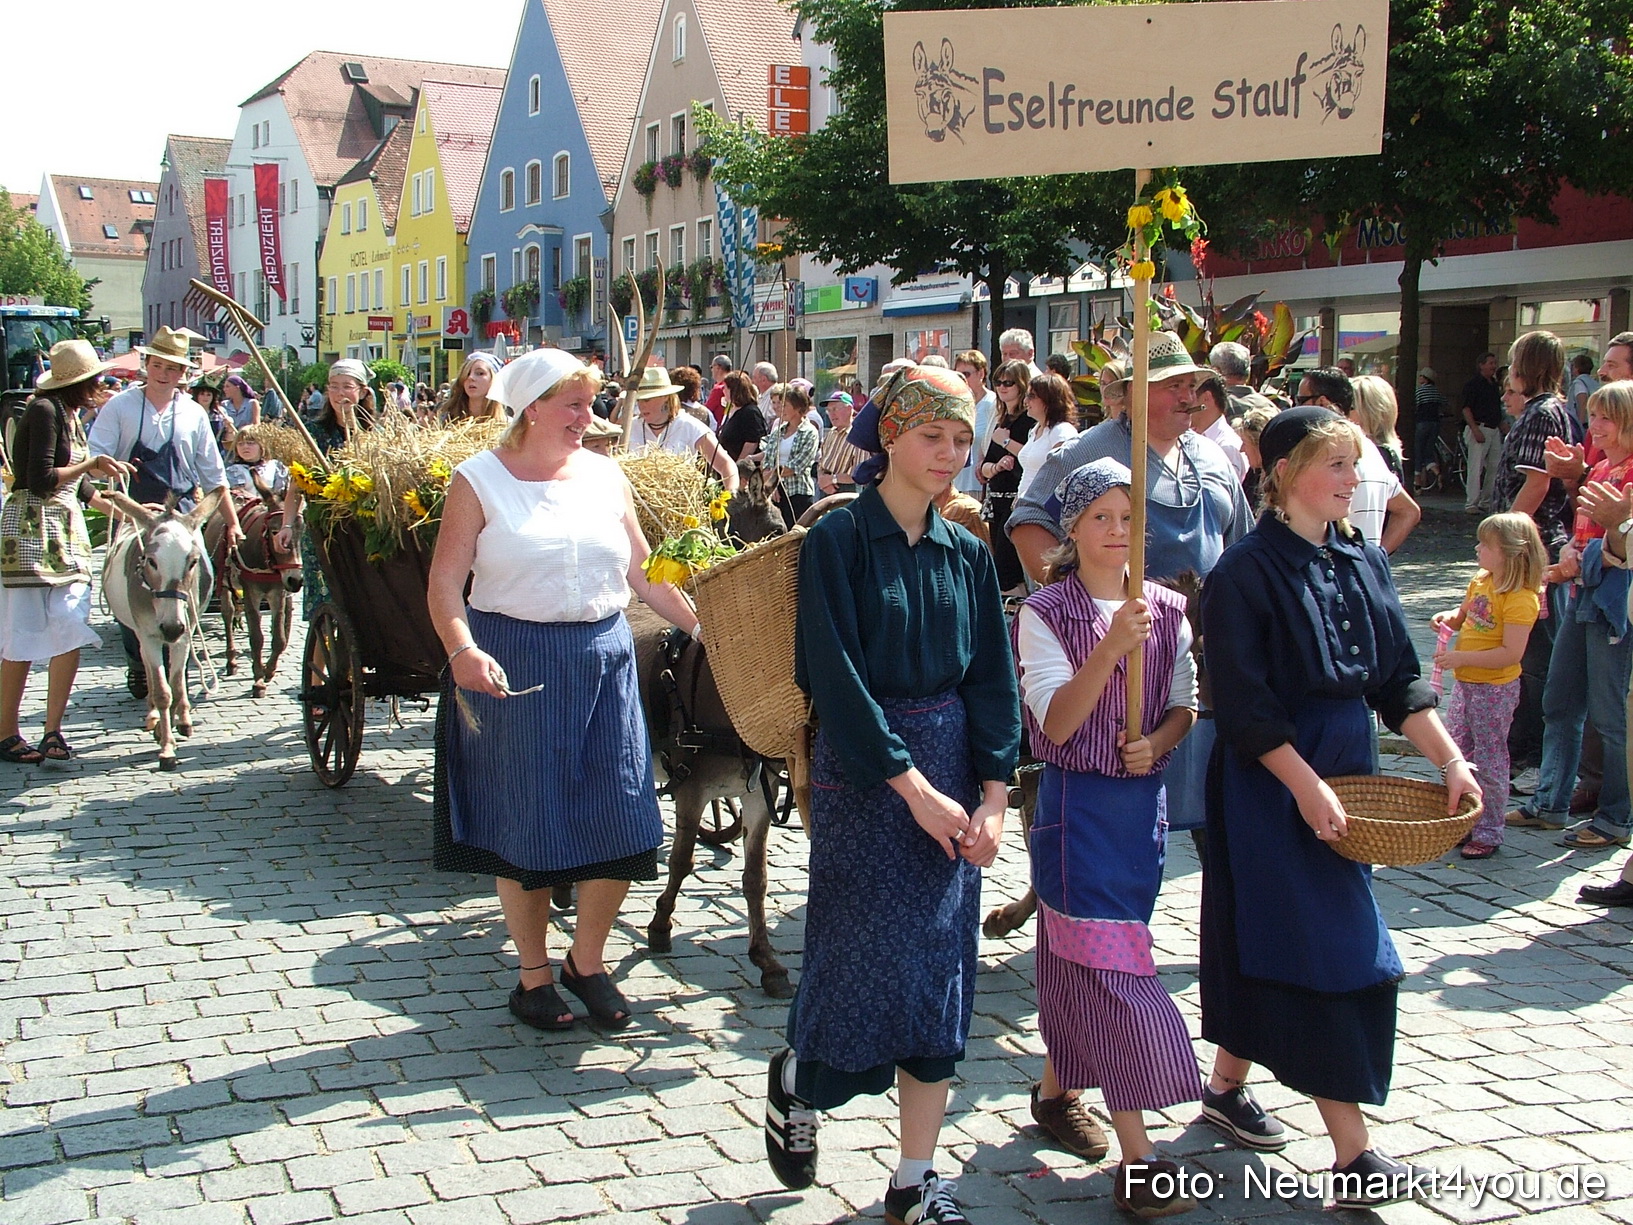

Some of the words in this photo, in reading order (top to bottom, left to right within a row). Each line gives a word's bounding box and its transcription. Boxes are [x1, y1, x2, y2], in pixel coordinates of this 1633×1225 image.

[982, 67, 1194, 134] Eselfreunde
[1211, 52, 1308, 119] Stauf
[260, 206, 280, 284] REDUZIERT
[351, 251, 368, 267] HOTEL
